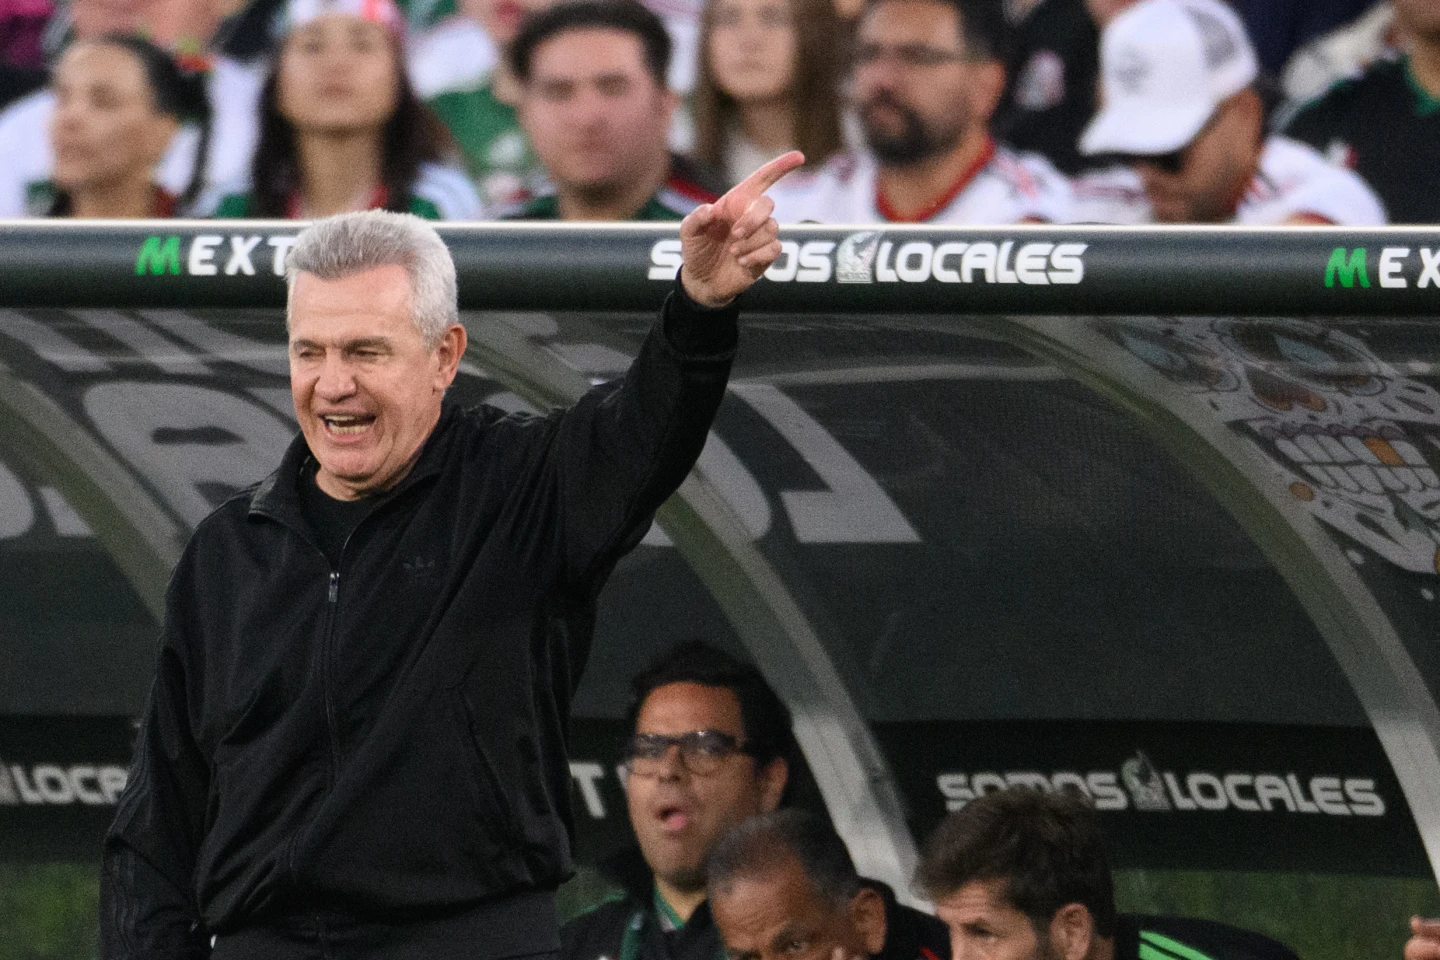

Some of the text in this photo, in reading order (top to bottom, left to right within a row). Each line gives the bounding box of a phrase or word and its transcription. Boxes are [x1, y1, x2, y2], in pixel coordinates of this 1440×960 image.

[135, 235, 297, 277] MEXT
[648, 240, 1088, 284] SOS LOCALES
[10, 764, 129, 804] LOCA
[1163, 773, 1386, 817] LOCALES
